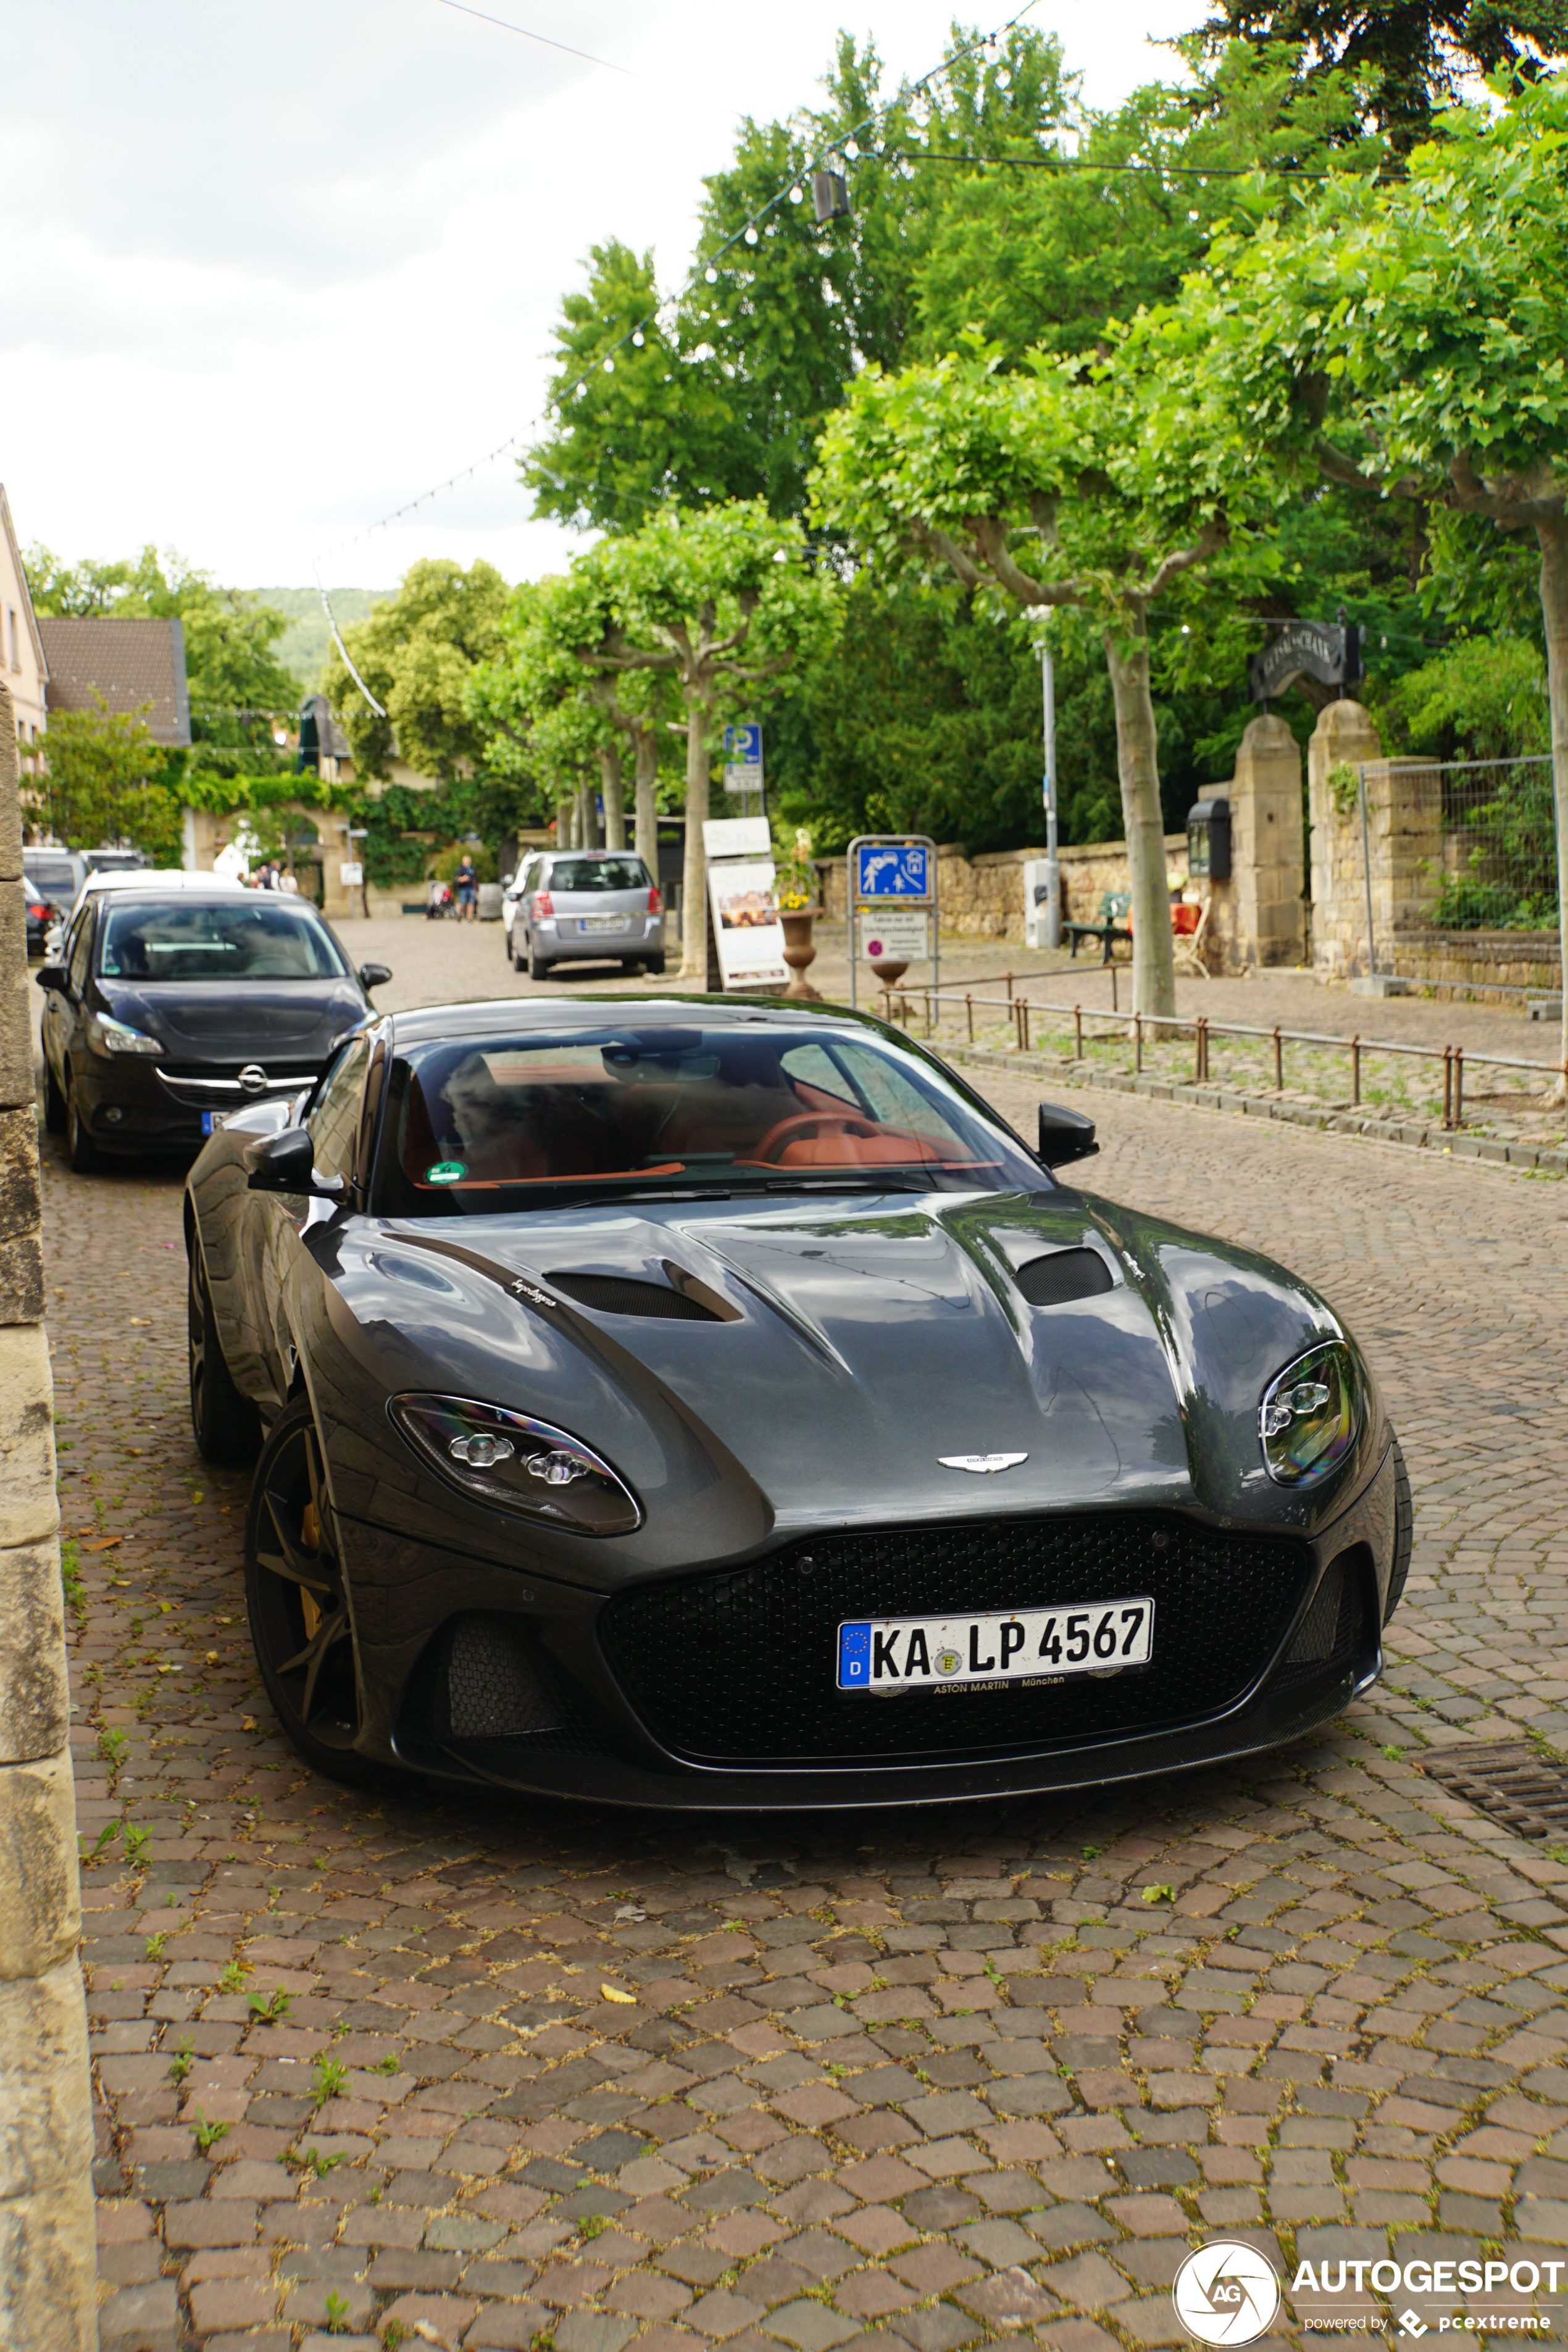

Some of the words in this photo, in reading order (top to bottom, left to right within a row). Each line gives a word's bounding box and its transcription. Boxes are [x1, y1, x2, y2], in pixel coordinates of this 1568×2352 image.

[874, 1628, 930, 1679] KA
[969, 1621, 1025, 1672] LP
[1039, 1607, 1144, 1664] 4567
[850, 1661, 861, 1675] D
[933, 1683, 967, 1694] ASTON
[970, 1680, 1009, 1692] MARTIN
[1022, 1675, 1065, 1688] München
